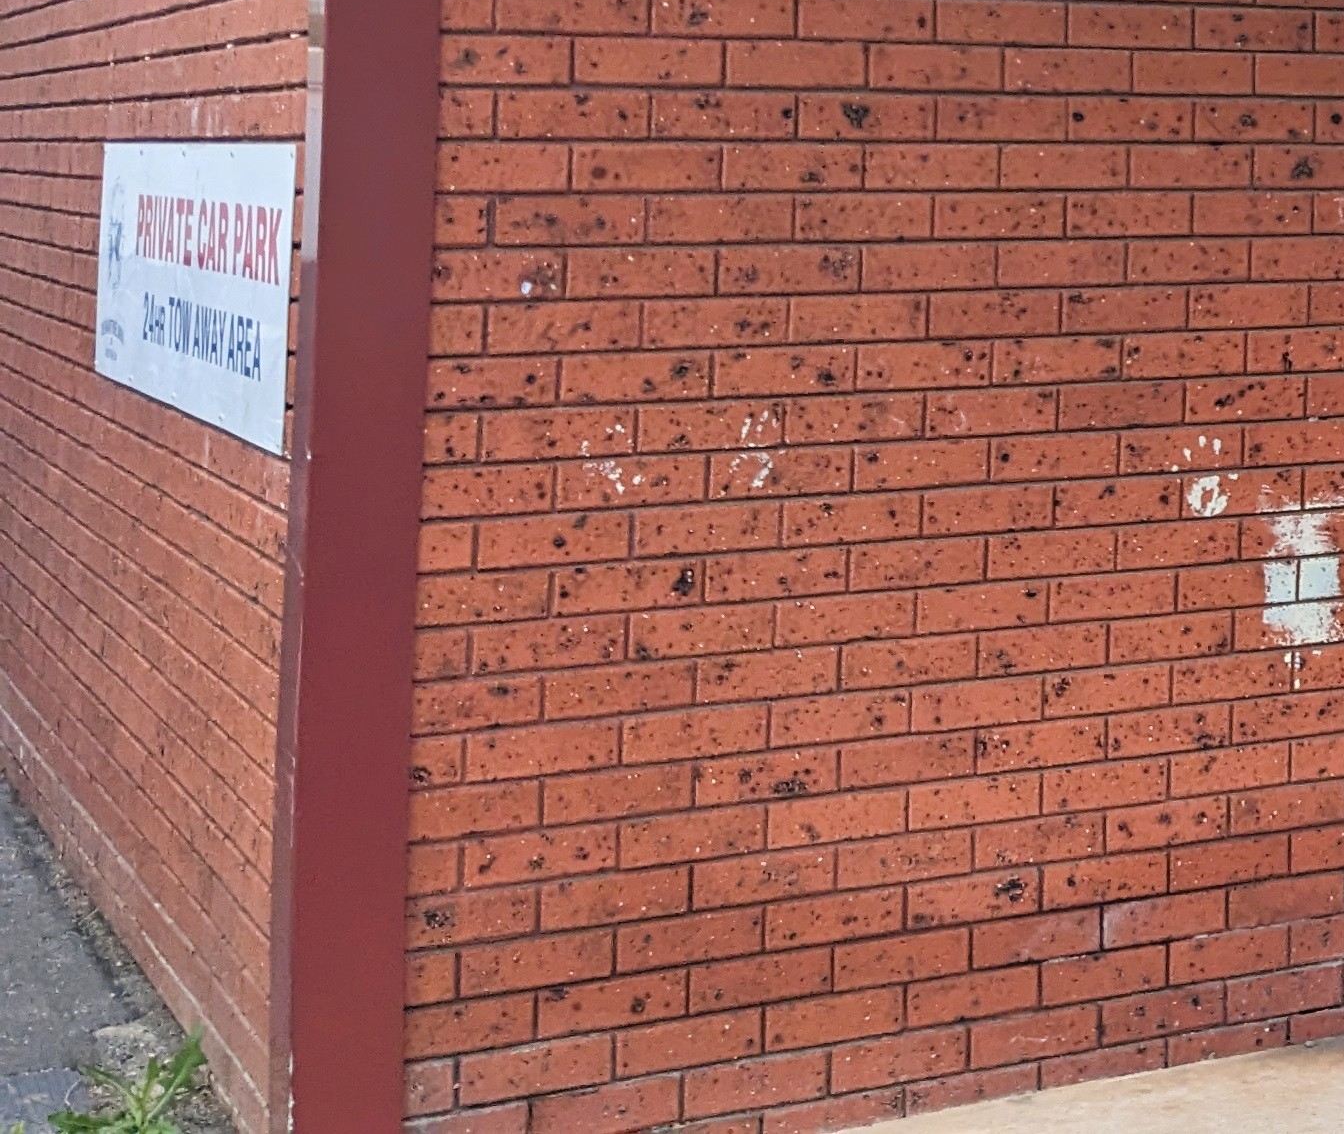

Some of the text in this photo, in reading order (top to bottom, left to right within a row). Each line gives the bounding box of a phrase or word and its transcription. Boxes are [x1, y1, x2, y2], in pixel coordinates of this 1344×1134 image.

[136, 194, 283, 286] PRIVATE CAR PARK
[168, 296, 192, 356] TOW
[193, 304, 227, 367] AWAY
[226, 313, 262, 382] AREA
